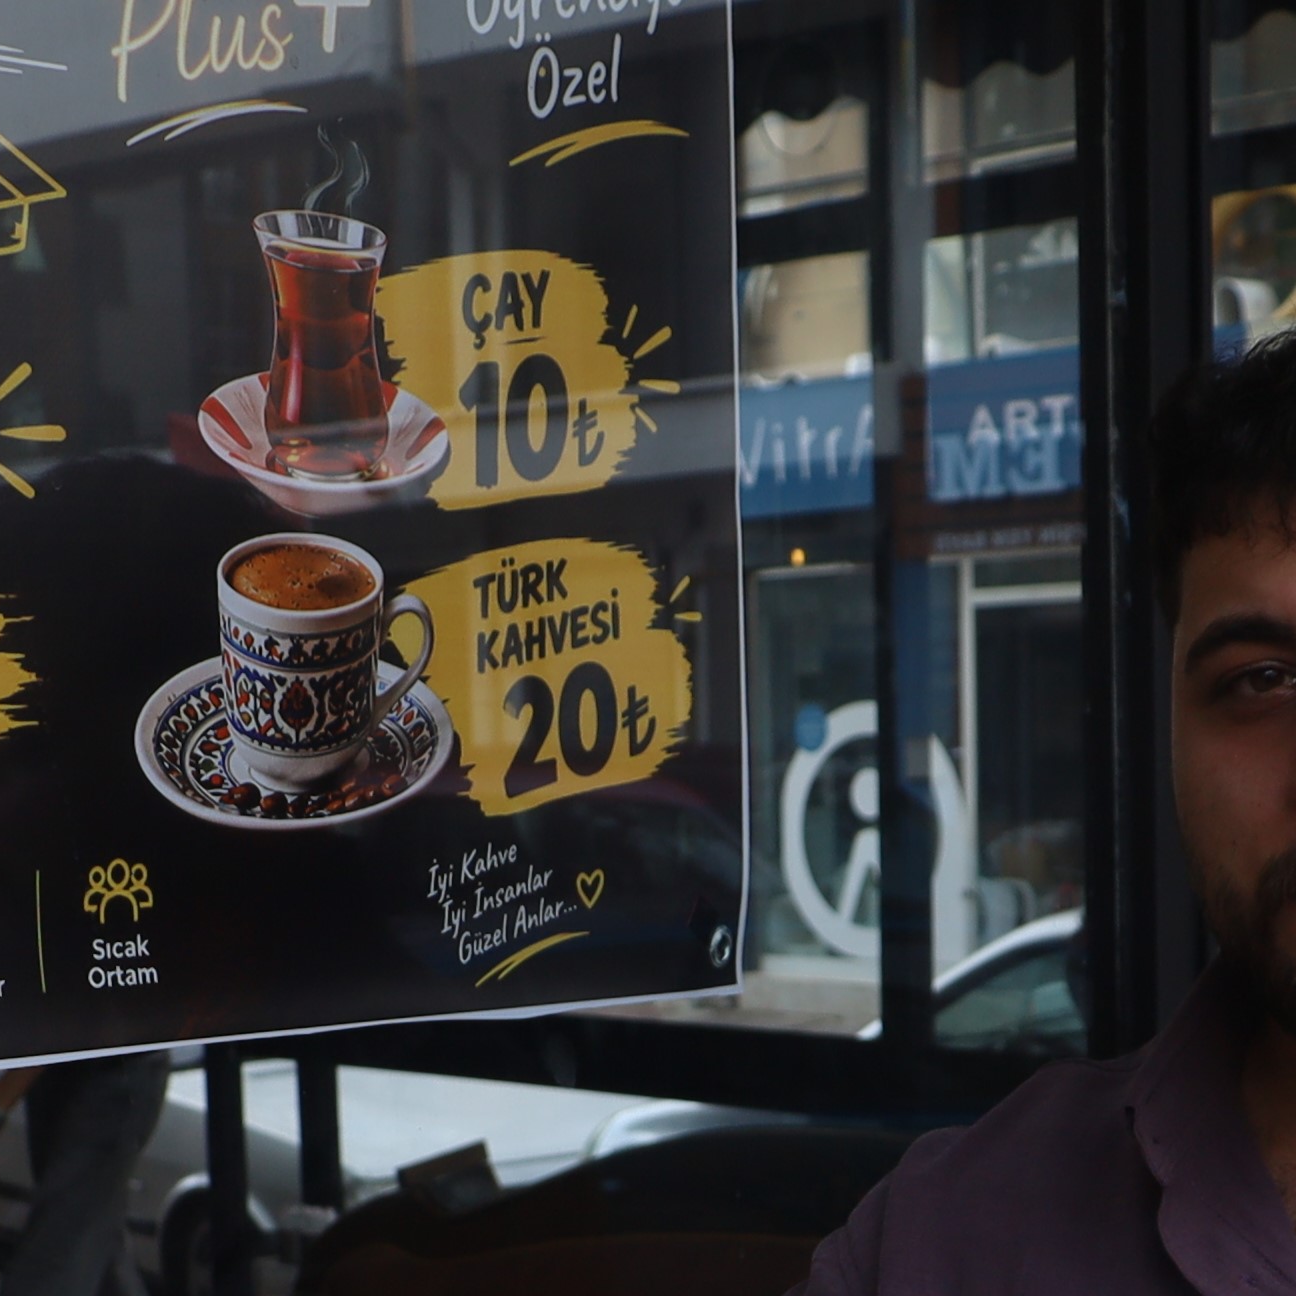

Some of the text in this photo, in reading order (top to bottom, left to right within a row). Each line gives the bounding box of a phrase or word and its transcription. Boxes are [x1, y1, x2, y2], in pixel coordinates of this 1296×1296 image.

[527, 32, 622, 119] Özel
[461, 269, 551, 349] ÇAY
[968, 394, 1075, 448] ART
[473, 557, 569, 620] TÜRK
[477, 589, 621, 673] KAHVESİ
[426, 842, 517, 903] İyi Kahve
[440, 864, 554, 939] İyi İnsanlar
[91, 934, 151, 961] Sıcak
[458, 896, 578, 965] Güzel Anlar...
[88, 963, 159, 990] Ortam
